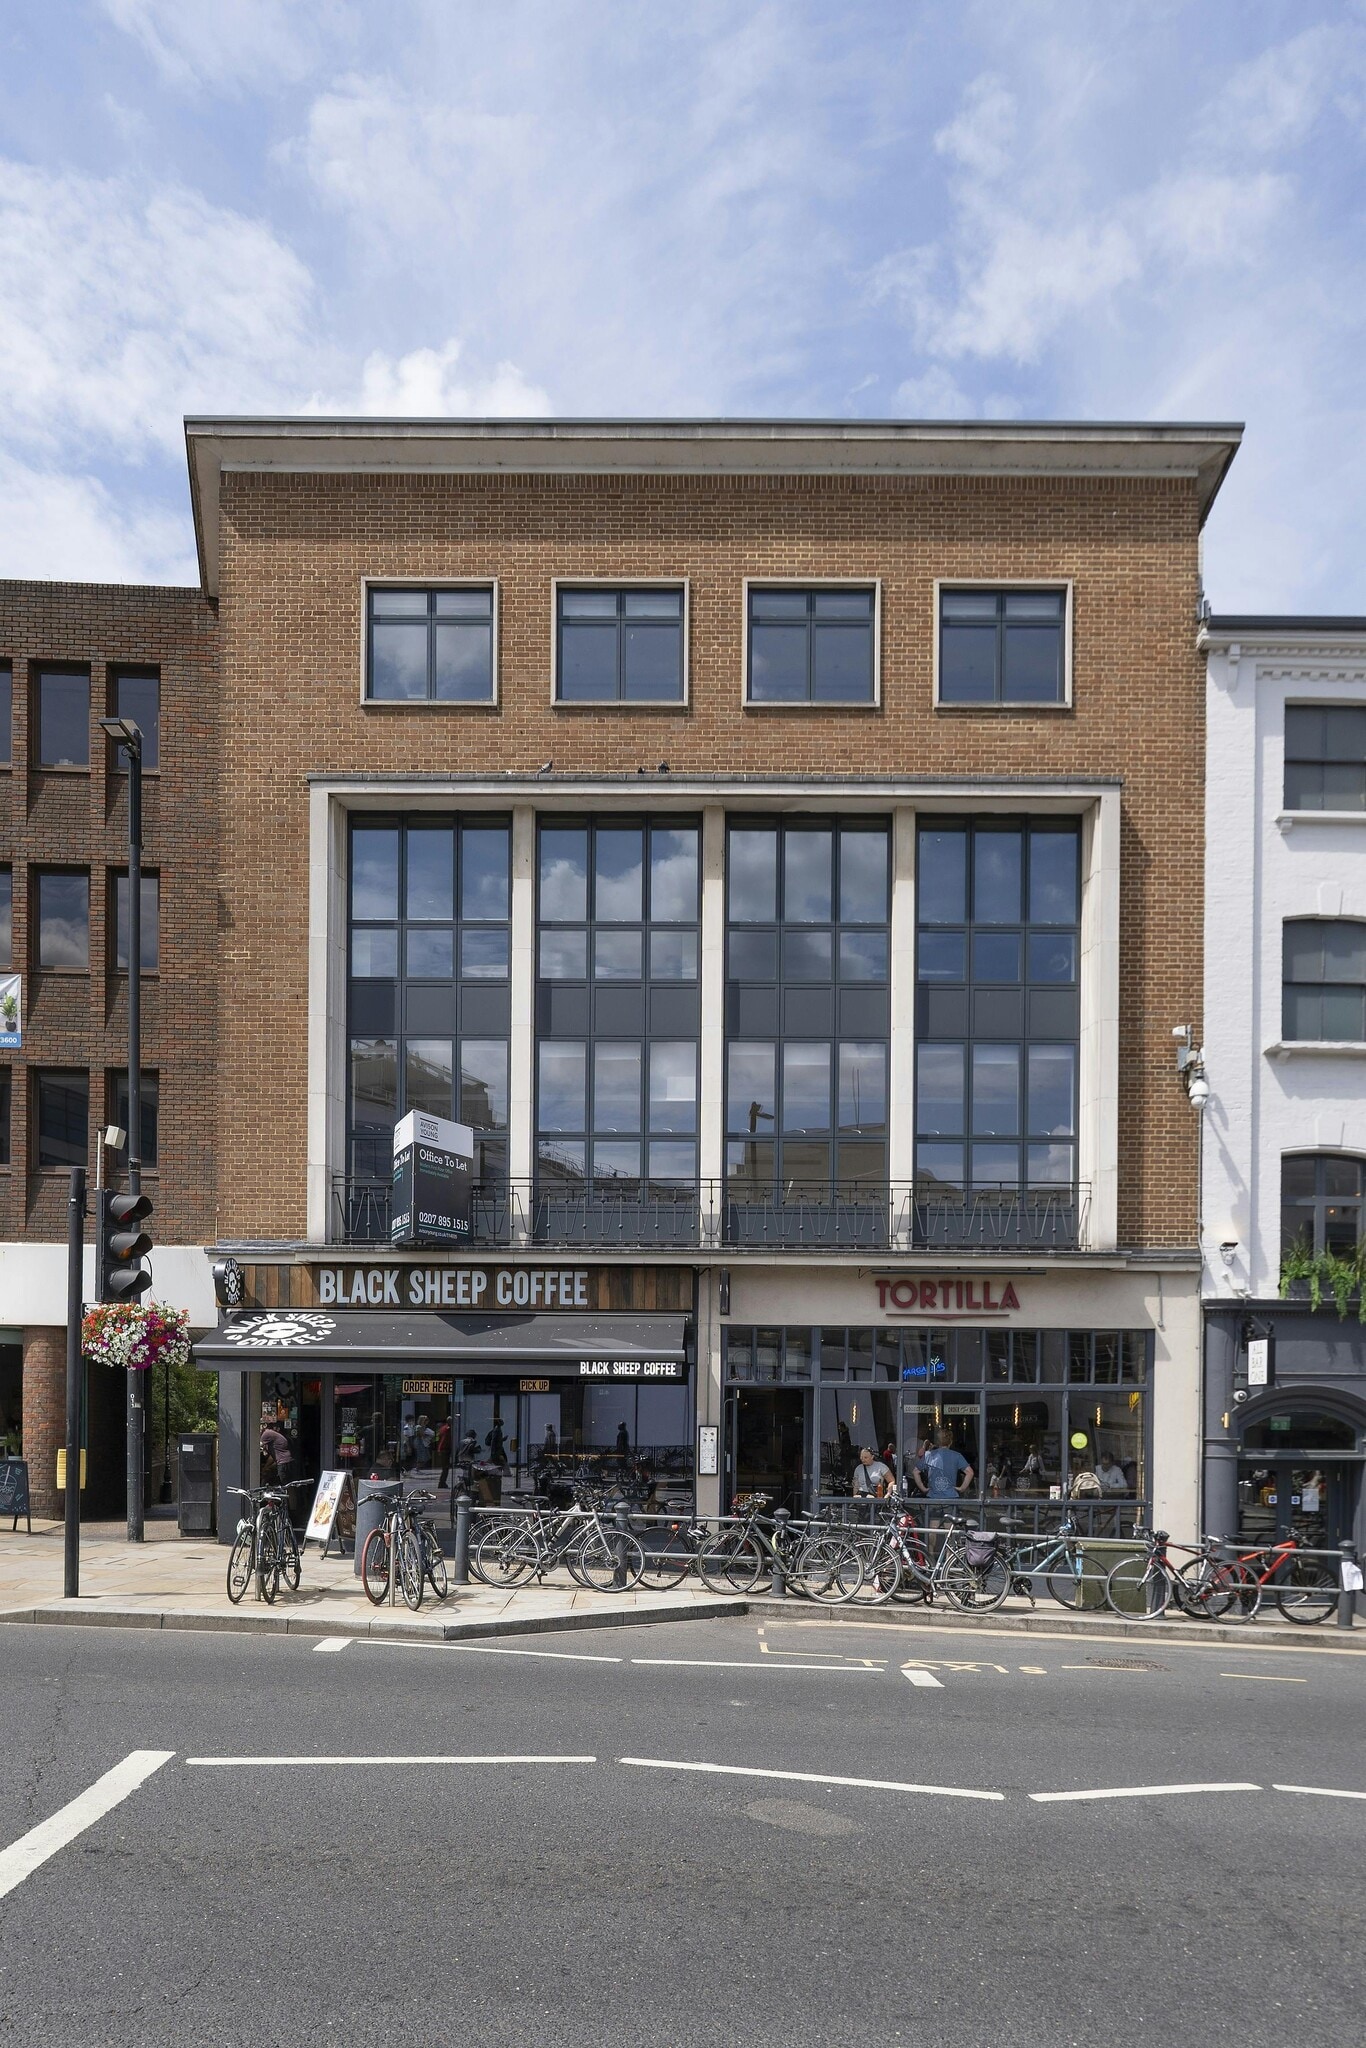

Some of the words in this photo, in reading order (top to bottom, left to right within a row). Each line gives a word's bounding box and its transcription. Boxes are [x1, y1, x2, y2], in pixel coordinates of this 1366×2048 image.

[420, 1121, 439, 1132] AVISON
[420, 1128, 439, 1139] YOUNG
[419, 1149, 443, 1165] Office
[444, 1156, 455, 1168] To
[456, 1159, 468, 1172] Let
[419, 1211, 437, 1225] 0207
[438, 1215, 451, 1228] 895
[453, 1218, 469, 1231] 1515
[320, 1268, 399, 1304] BLACK
[408, 1270, 488, 1305] SHEEP
[496, 1271, 588, 1306] COFFEE
[875, 1279, 1021, 1309] TORTILLA
[223, 1313, 281, 1334] BLACK
[284, 1313, 337, 1329] SHEEP
[236, 1333, 325, 1346] COFFEE
[580, 1361, 610, 1375] BLACK
[612, 1362, 641, 1375] SHEEP
[643, 1362, 677, 1376] COFFEE
[404, 1381, 430, 1393] ORDER
[432, 1381, 453, 1393] HERE
[521, 1380, 537, 1391] PICK
[539, 1380, 549, 1391] UP
[845, 1657, 1048, 1675] TAXIS
